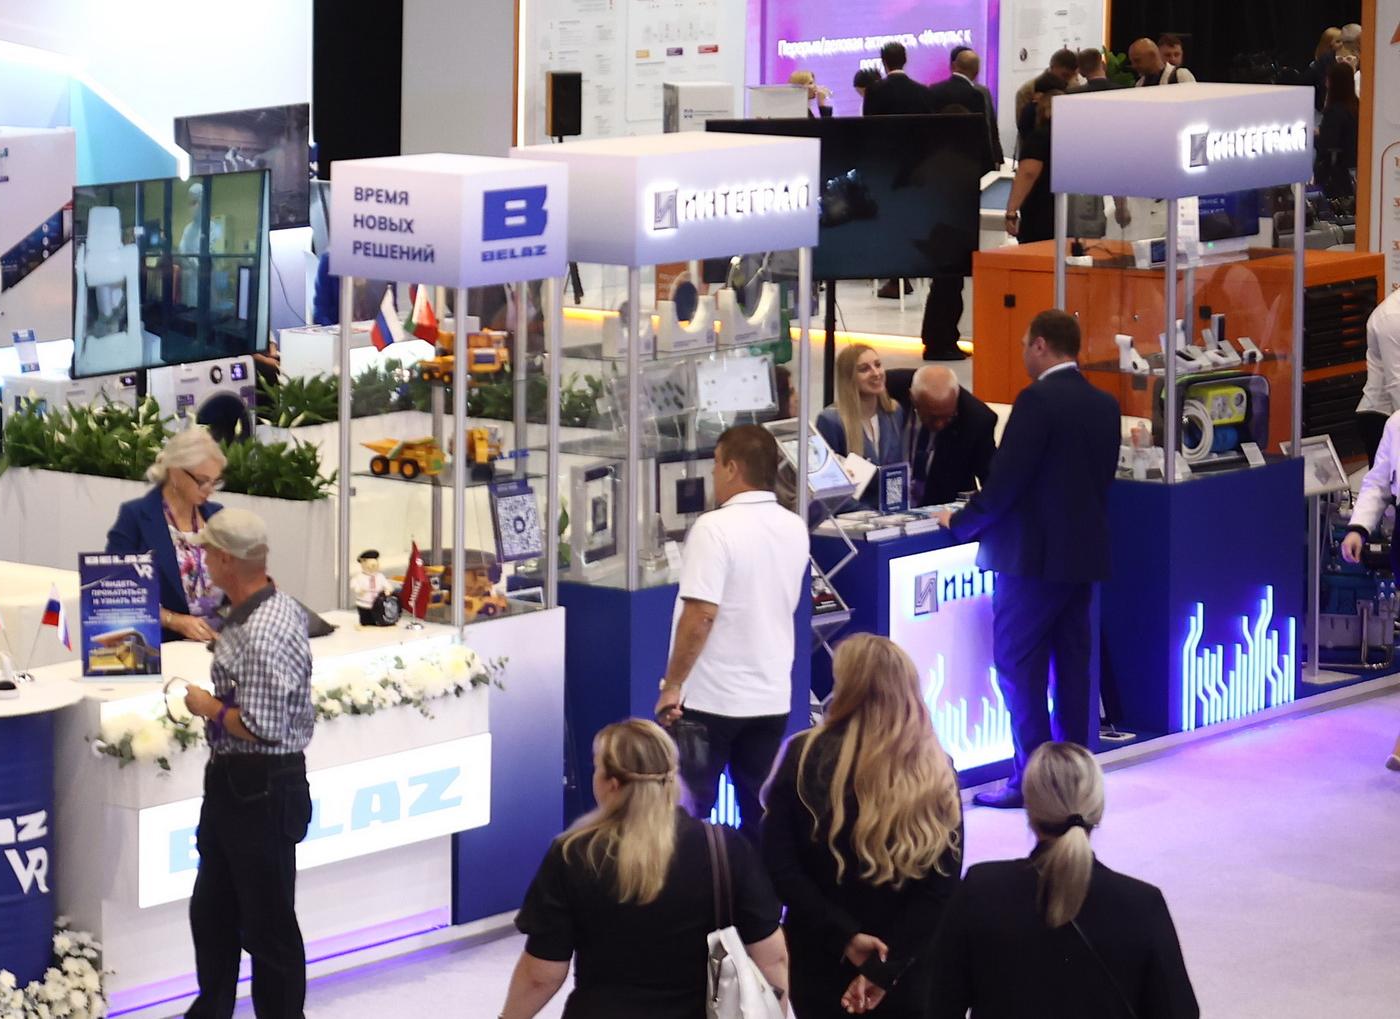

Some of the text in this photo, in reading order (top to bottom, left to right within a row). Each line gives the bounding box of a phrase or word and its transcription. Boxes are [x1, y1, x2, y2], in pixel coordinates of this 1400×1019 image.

[354, 186, 409, 206] ВРЕМЯ
[353, 213, 415, 234] НОВЫХ
[352, 240, 435, 264] РЕШЕНИЙ
[481, 244, 547, 263] BELAZ
[84, 554, 153, 566] BELAZ
[133, 563, 153, 579] VR
[944, 568, 997, 602] ИНТ
[168, 766, 463, 874] BLAZ
[4, 847, 50, 895] VR
